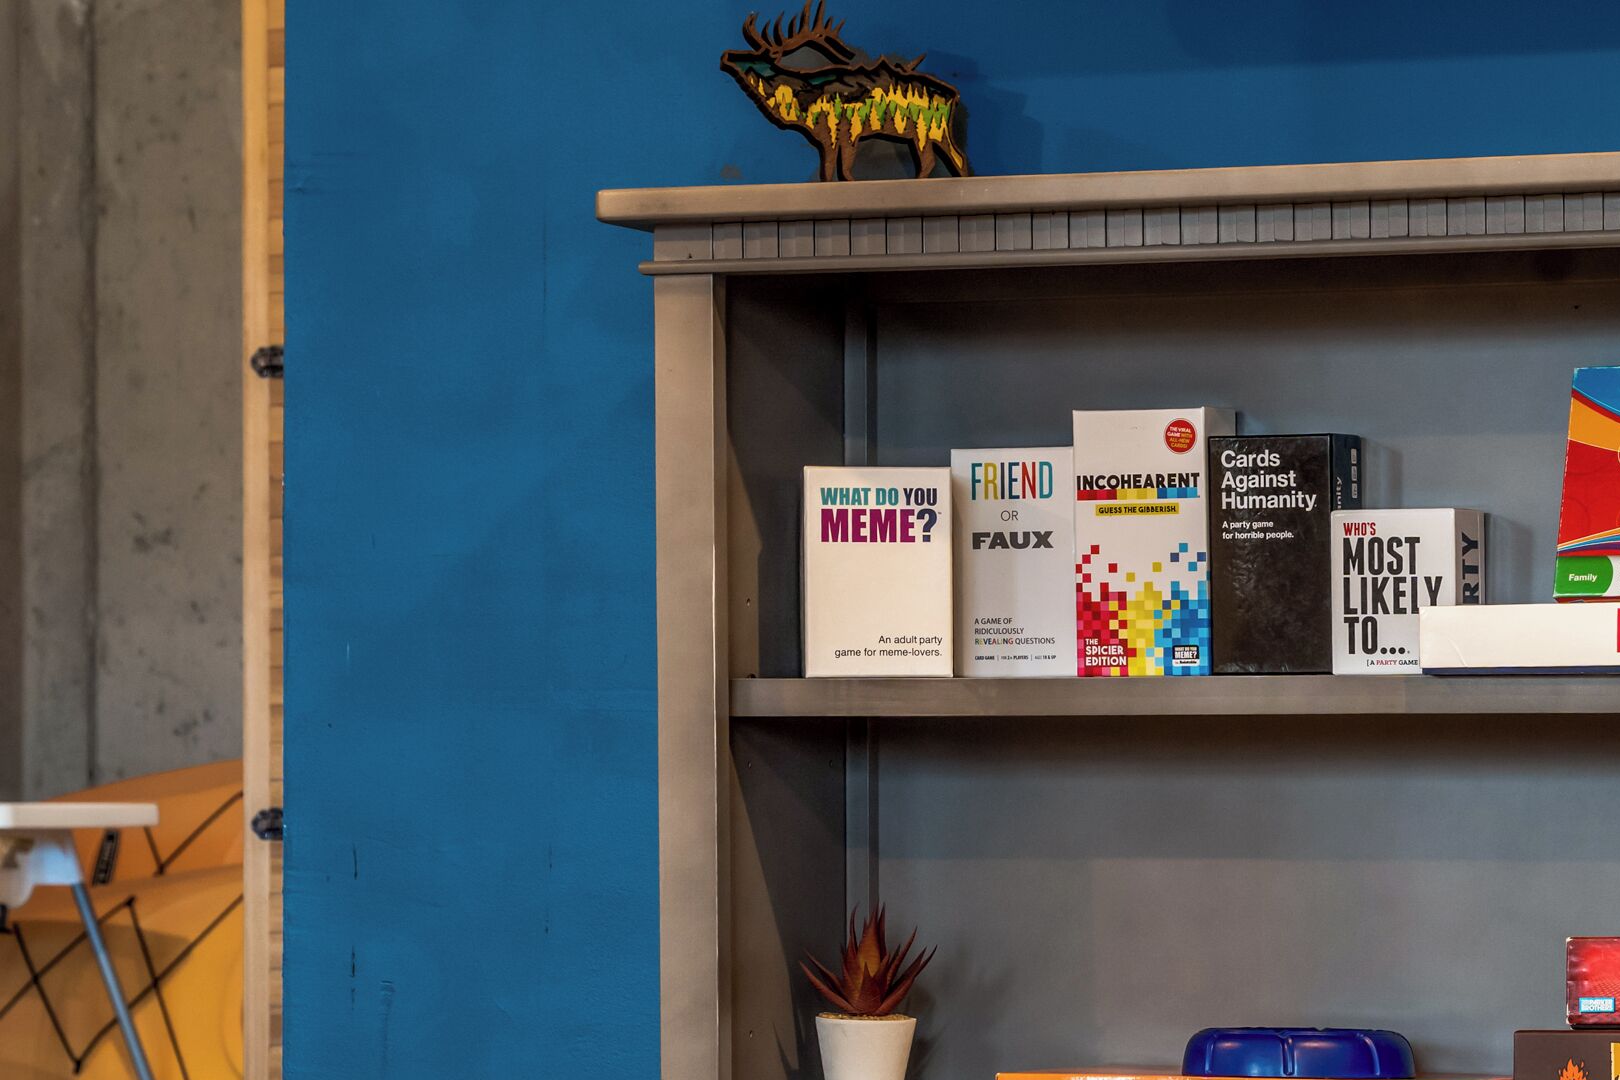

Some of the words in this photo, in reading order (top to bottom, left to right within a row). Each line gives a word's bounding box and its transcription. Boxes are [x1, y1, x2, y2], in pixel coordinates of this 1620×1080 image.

[1221, 450, 1280, 467] Cards
[971, 461, 1053, 501] FRIEND
[1076, 472, 1200, 490] INCOHEARENT
[1221, 470, 1296, 492] Against
[820, 488, 871, 506] WHAT
[875, 488, 899, 506] DO
[903, 488, 937, 506] YOU
[1098, 506, 1122, 514] GUESS
[1138, 505, 1176, 513] GIBBERISH
[1000, 510, 1018, 521] OR
[821, 509, 937, 542] MEME?
[1231, 521, 1250, 530] party
[1252, 522, 1274, 530] game
[1343, 522, 1376, 536] WHO'S
[972, 530, 1054, 550] FAUX
[1234, 531, 1265, 539] horrible
[1266, 532, 1294, 541] people.
[1342, 536, 1421, 575] MOST
[1568, 573, 1598, 583] Family
[1343, 575, 1443, 615] LIKELY
[981, 617, 1002, 625] GAME
[974, 627, 1024, 635] RIDICULOUSLY
[879, 635, 891, 644] An
[894, 635, 917, 644] adult
[919, 636, 943, 647] party
[1015, 637, 1056, 646] QUESTIONS
[835, 650, 862, 659] game
[864, 648, 876, 657] for
[879, 648, 943, 657] meme-lovers.
[1085, 646, 1124, 655] SPICIER
[1085, 656, 1127, 666] EDITION
